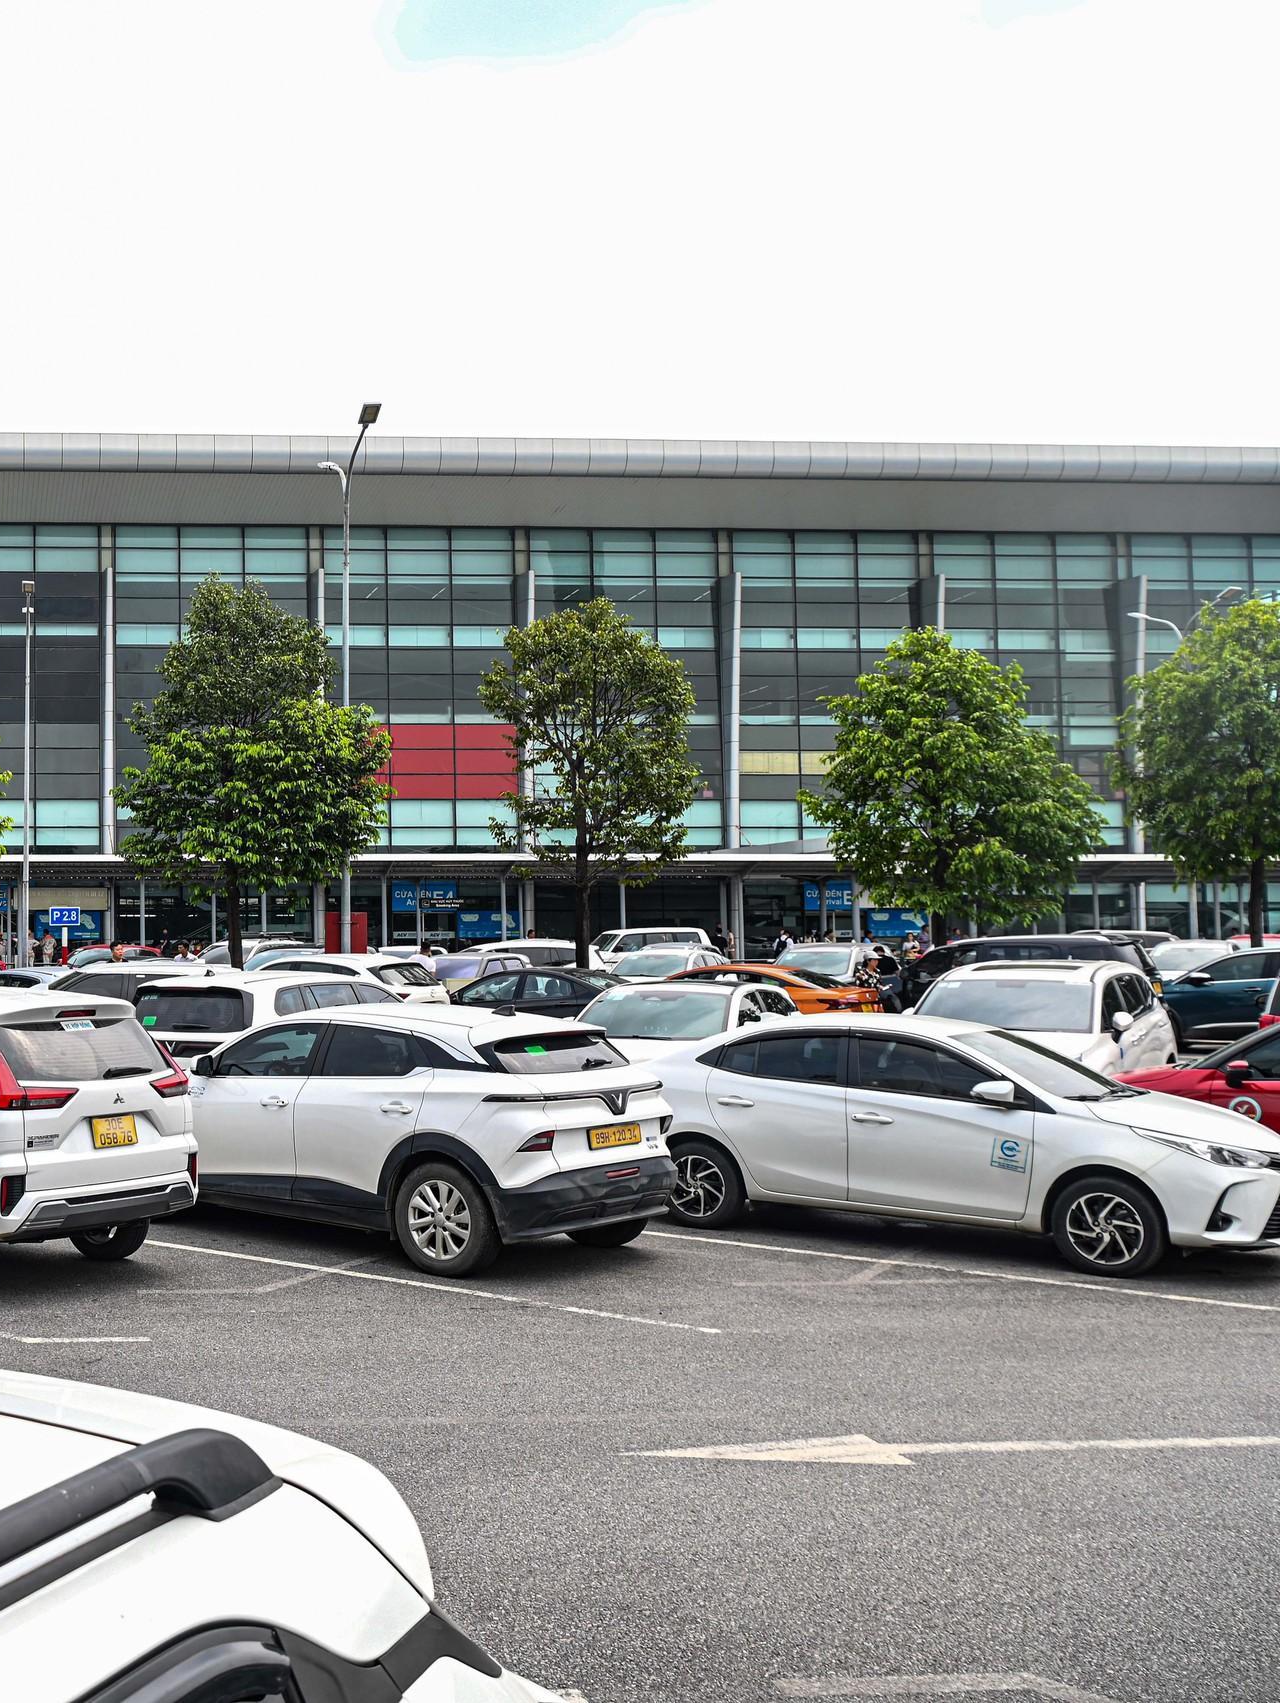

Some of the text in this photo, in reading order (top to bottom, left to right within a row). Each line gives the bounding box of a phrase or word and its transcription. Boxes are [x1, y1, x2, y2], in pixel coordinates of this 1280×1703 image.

[53, 911, 77, 921] P 2.8
[105, 1117, 125, 1132] 30E
[99, 1130, 134, 1146] 058.76
[595, 1127, 638, 1145] 89H-120.34
